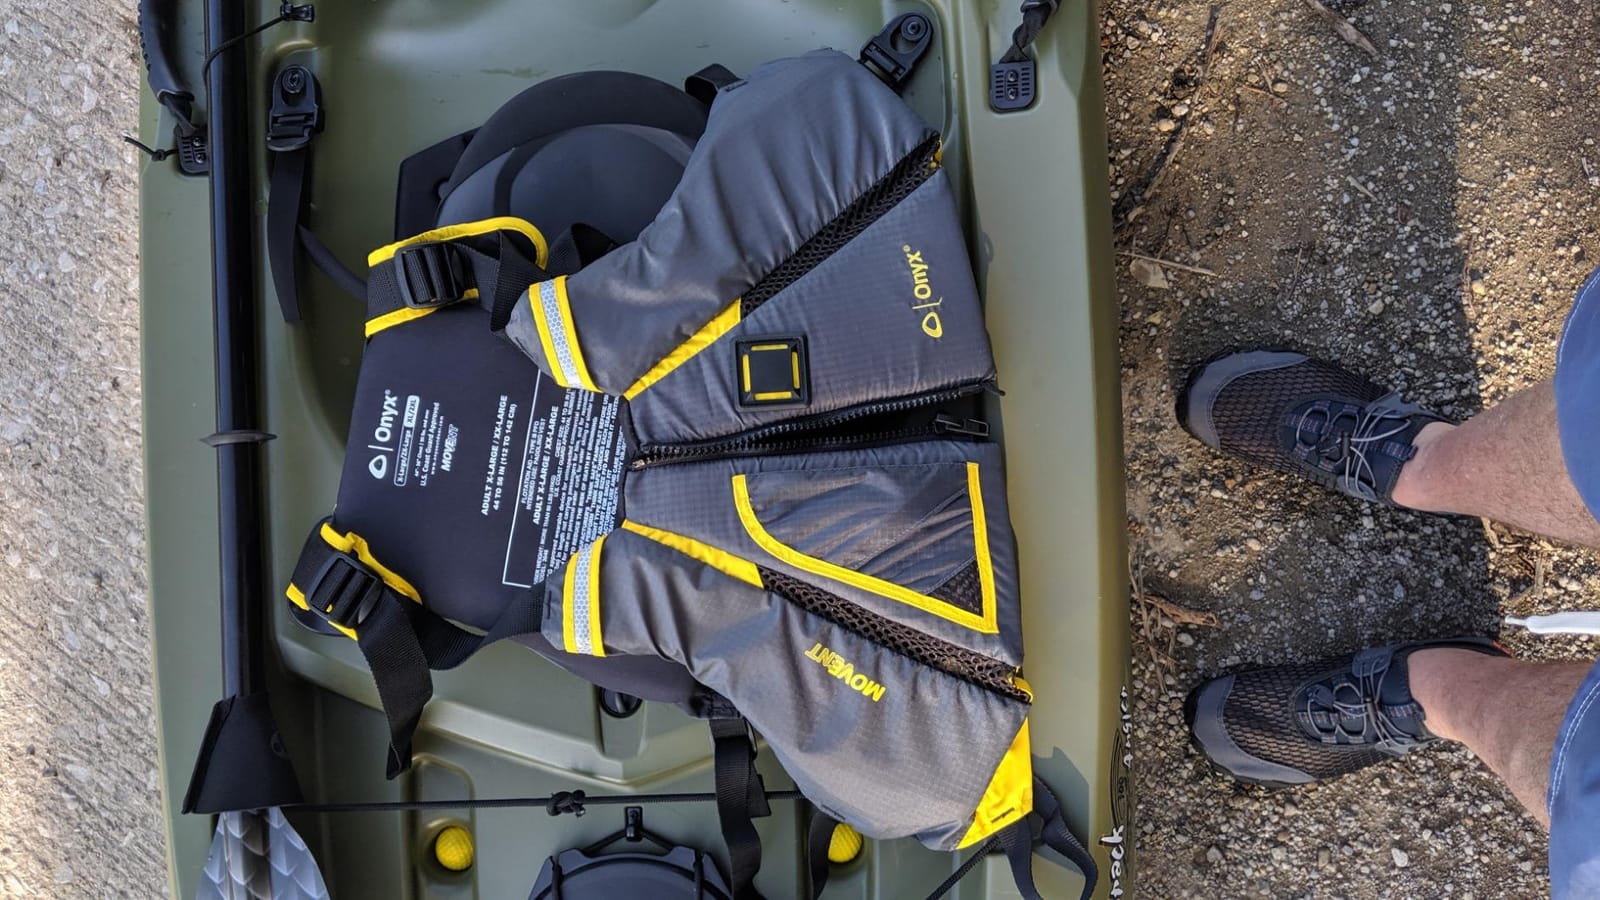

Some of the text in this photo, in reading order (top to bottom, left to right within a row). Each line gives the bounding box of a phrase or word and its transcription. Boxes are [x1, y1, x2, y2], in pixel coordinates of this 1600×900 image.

[407, 398, 416, 423] XL/2XL
[429, 402, 439, 433] Approved
[508, 404, 517, 418] CM)
[503, 436, 510, 446] TO
[562, 416, 571, 445] APPROVAL
[425, 434, 434, 453] Guard
[481, 485, 492, 515] ADULT
[487, 446, 498, 483] X-LARGE
[494, 396, 507, 439] XX-LARGE
[422, 455, 430, 472] Coast
[498, 466, 505, 475] IN
[527, 480, 535, 509] INTENDED
[534, 434, 542, 464] PADDLING
[533, 495, 543, 524] ADULT
[538, 456, 550, 493] X-LARGE
[545, 406, 558, 449] XX-LARGE
[495, 488, 502, 498] TO
[521, 471, 531, 503] FLOTATION
[493, 500, 500, 510] 44
[572, 521, 580, 545] REDUCE
[804, 642, 886, 702] MOVENT
